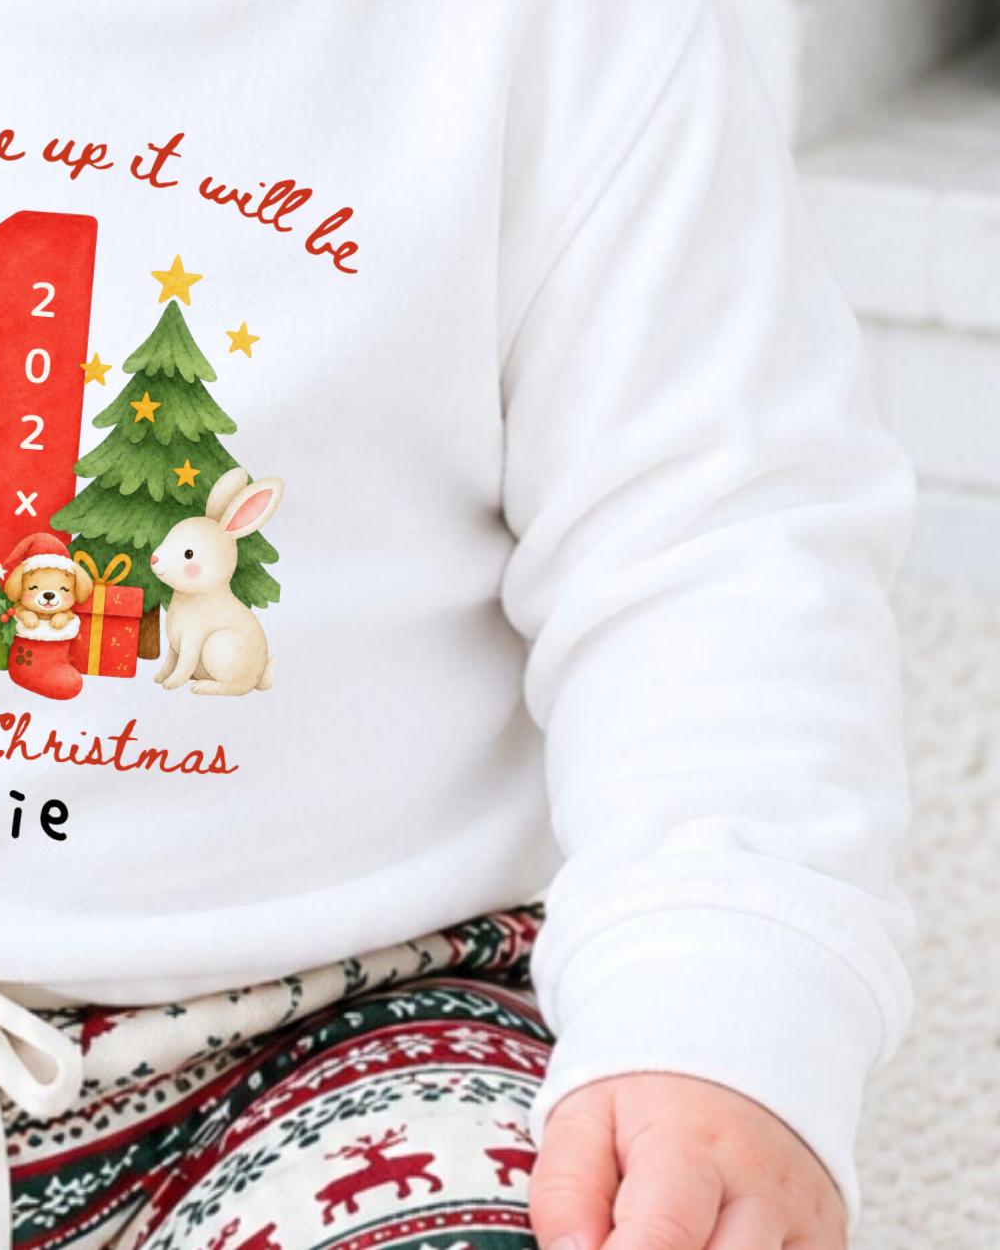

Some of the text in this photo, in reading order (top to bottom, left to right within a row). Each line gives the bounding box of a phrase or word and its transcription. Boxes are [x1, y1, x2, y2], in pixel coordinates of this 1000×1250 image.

[42, 138, 114, 180] up
[130, 132, 185, 189] it
[199, 176, 312, 233] will
[304, 206, 359, 275] be
